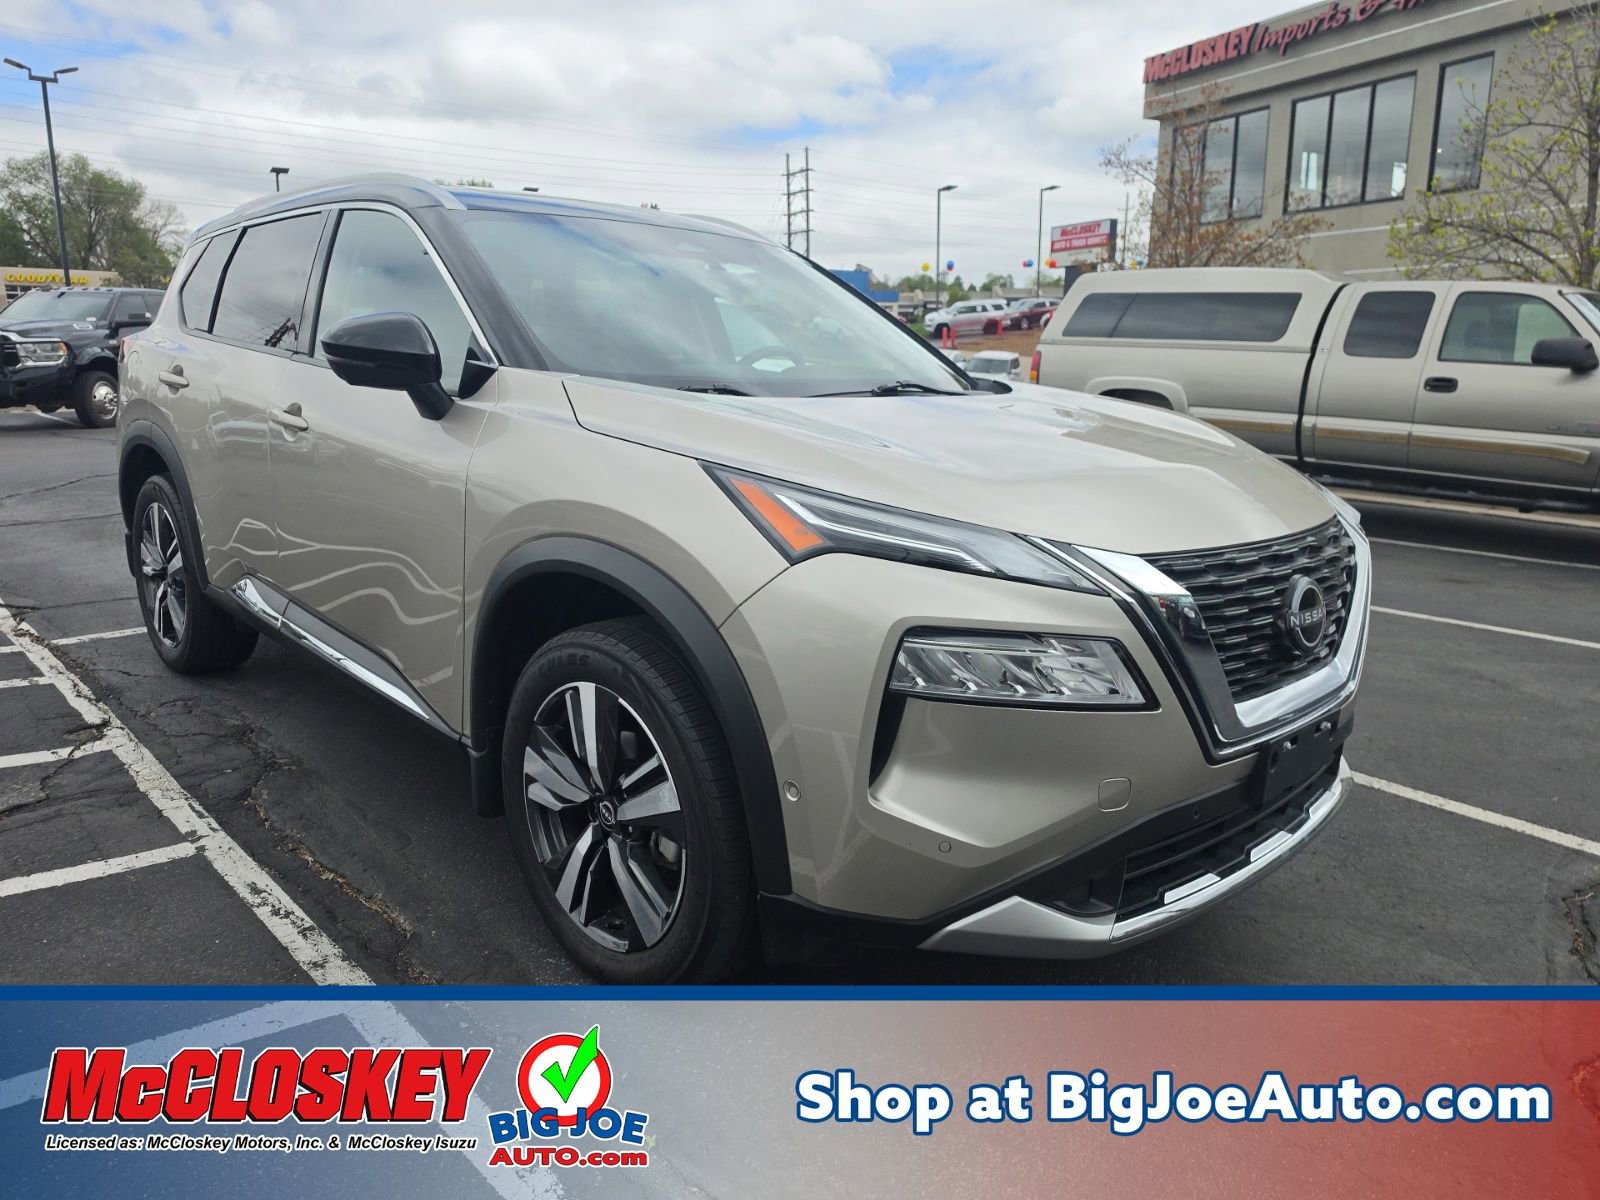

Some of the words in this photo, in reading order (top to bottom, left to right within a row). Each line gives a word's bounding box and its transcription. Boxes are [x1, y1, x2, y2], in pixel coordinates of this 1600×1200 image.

[1255, 2, 1348, 56] Imports
[5, 273, 88, 285] GOODYAR
[1290, 609, 1323, 627] NISSA
